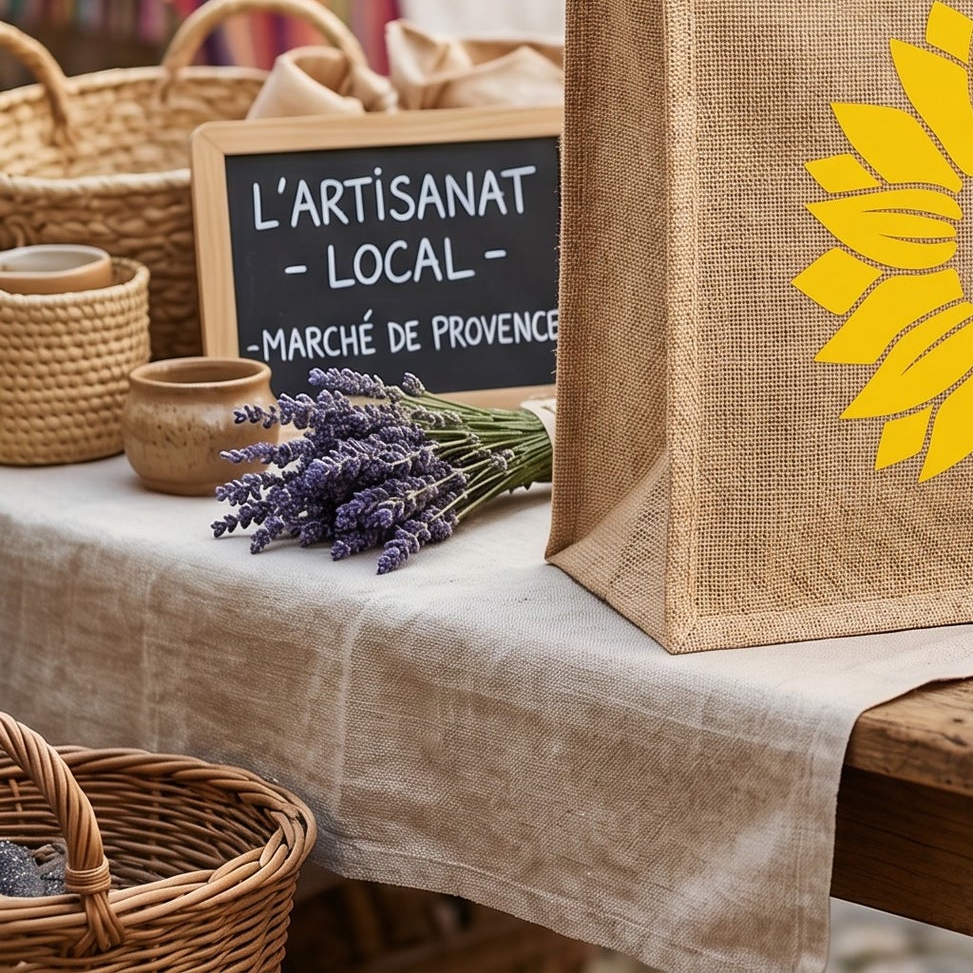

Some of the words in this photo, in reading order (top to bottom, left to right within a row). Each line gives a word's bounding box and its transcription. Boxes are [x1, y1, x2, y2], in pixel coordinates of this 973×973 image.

[327, 237, 475, 289] LOCAL
[388, 320, 421, 354] DE
[432, 309, 558, 351] PROVENCE
